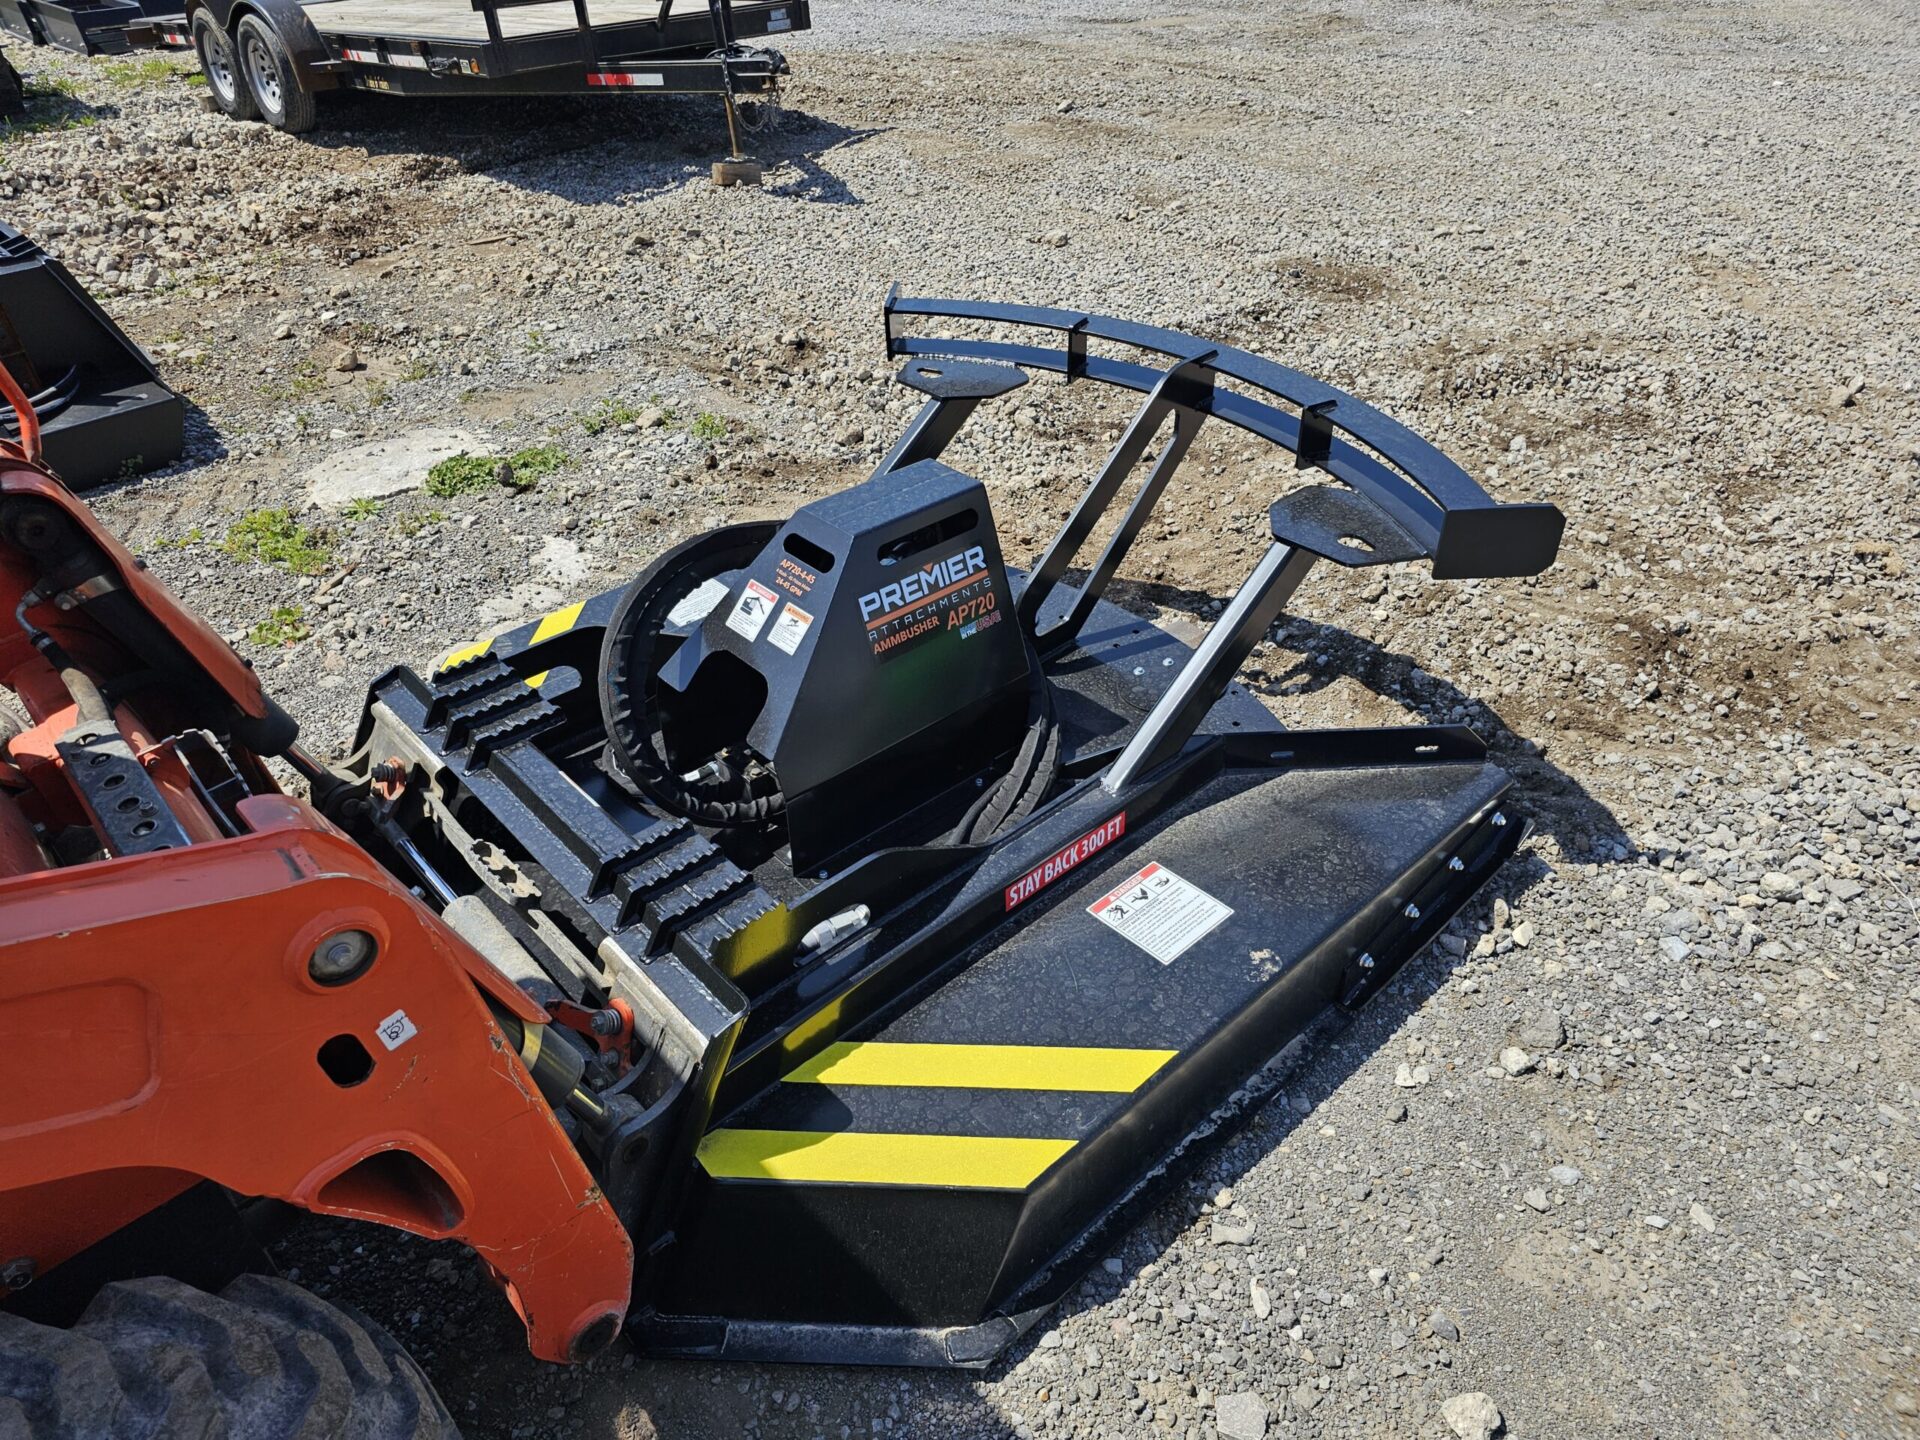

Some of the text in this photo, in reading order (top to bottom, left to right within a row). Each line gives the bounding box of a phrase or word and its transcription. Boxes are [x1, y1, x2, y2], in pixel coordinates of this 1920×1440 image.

[780, 559, 816, 583] AP720-4-45
[858, 546, 986, 621] PREMIER
[869, 578, 991, 641] ATTACHMENTS
[872, 592, 994, 655] AMMBUSHER AP720
[1009, 816, 1121, 906] STAY BACK 300 FT
[1115, 875, 1143, 896] DANGER
